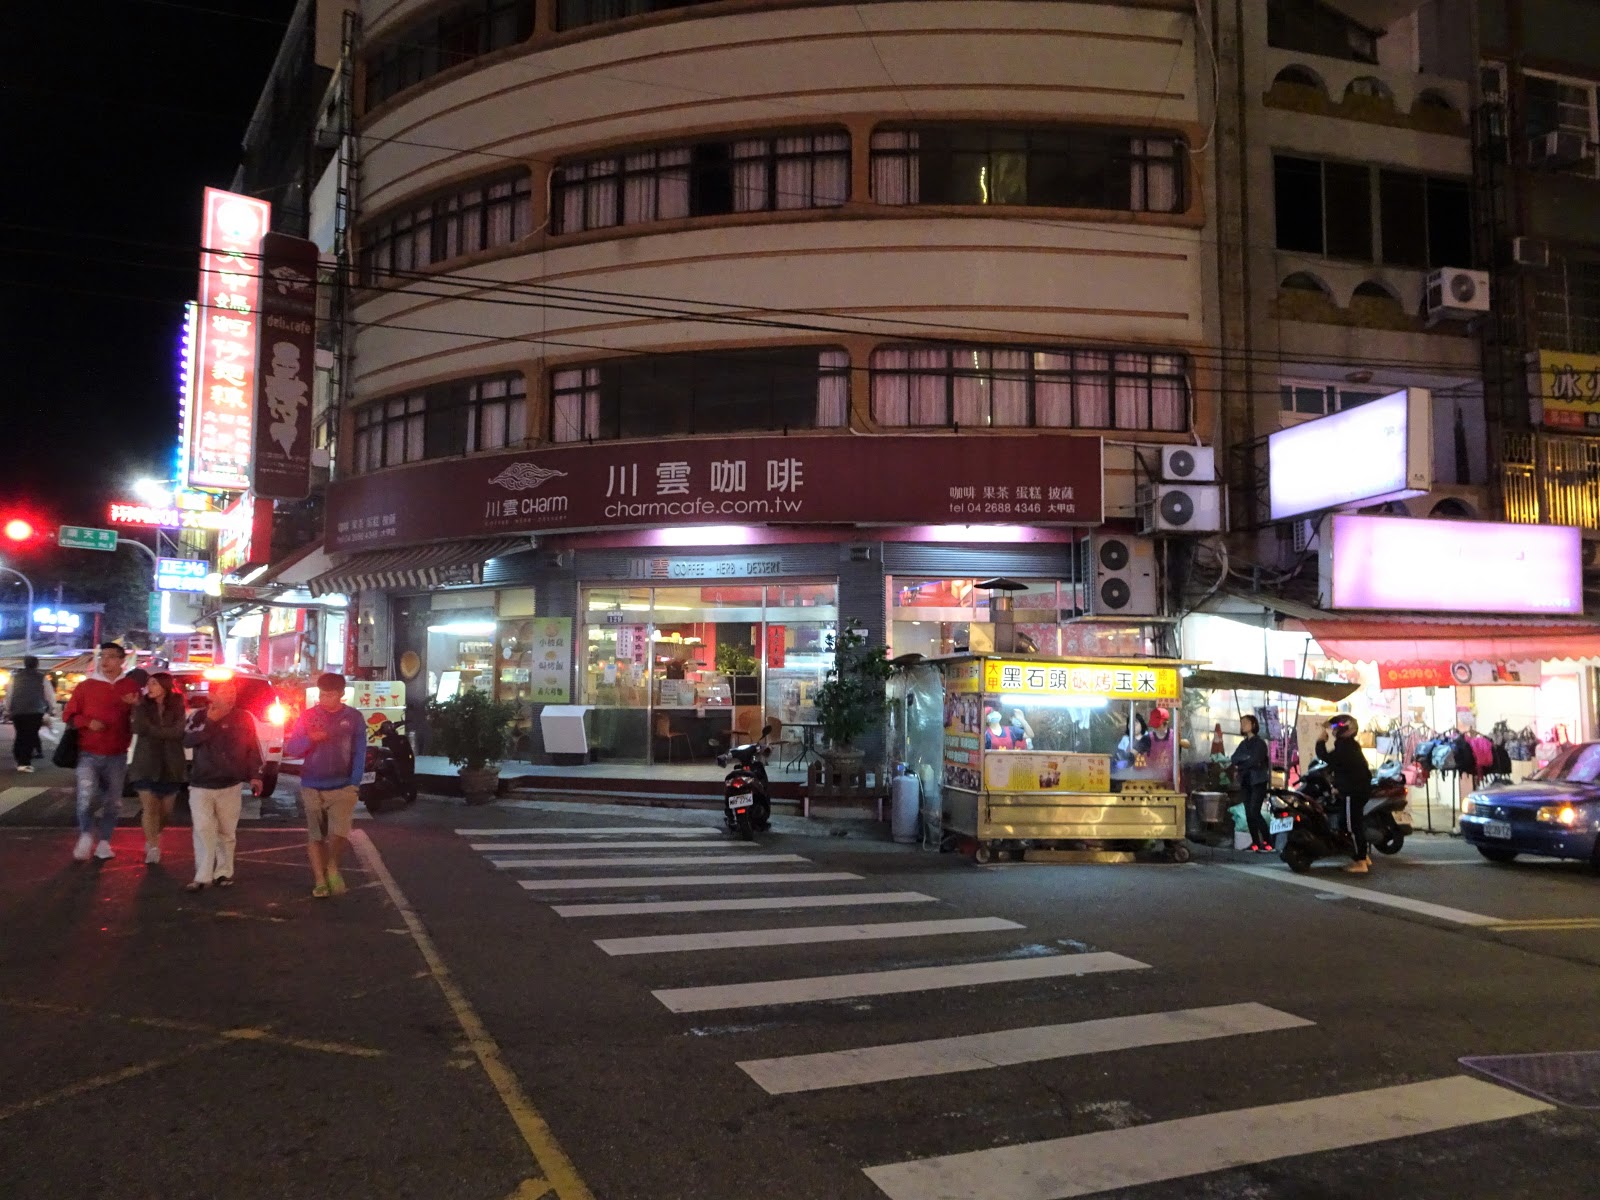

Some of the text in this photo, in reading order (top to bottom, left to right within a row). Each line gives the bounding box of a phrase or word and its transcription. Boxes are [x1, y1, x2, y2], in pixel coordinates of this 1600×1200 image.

[605, 457, 804, 498] 川雲咖啡
[949, 485, 1075, 500] 咖啡 果茶 蛋糕 披薩
[485, 498, 519, 518] 川雲
[604, 497, 803, 518] charmcafe.com.tw
[949, 503, 1075, 514] tel 04 2688 4346 大甲店
[627, 558, 781, 579] 川雲 COFFEE HERB DESSERT
[988, 663, 998, 689] 大甲
[1001, 667, 1156, 693] 黑石頭碳烤玉米
